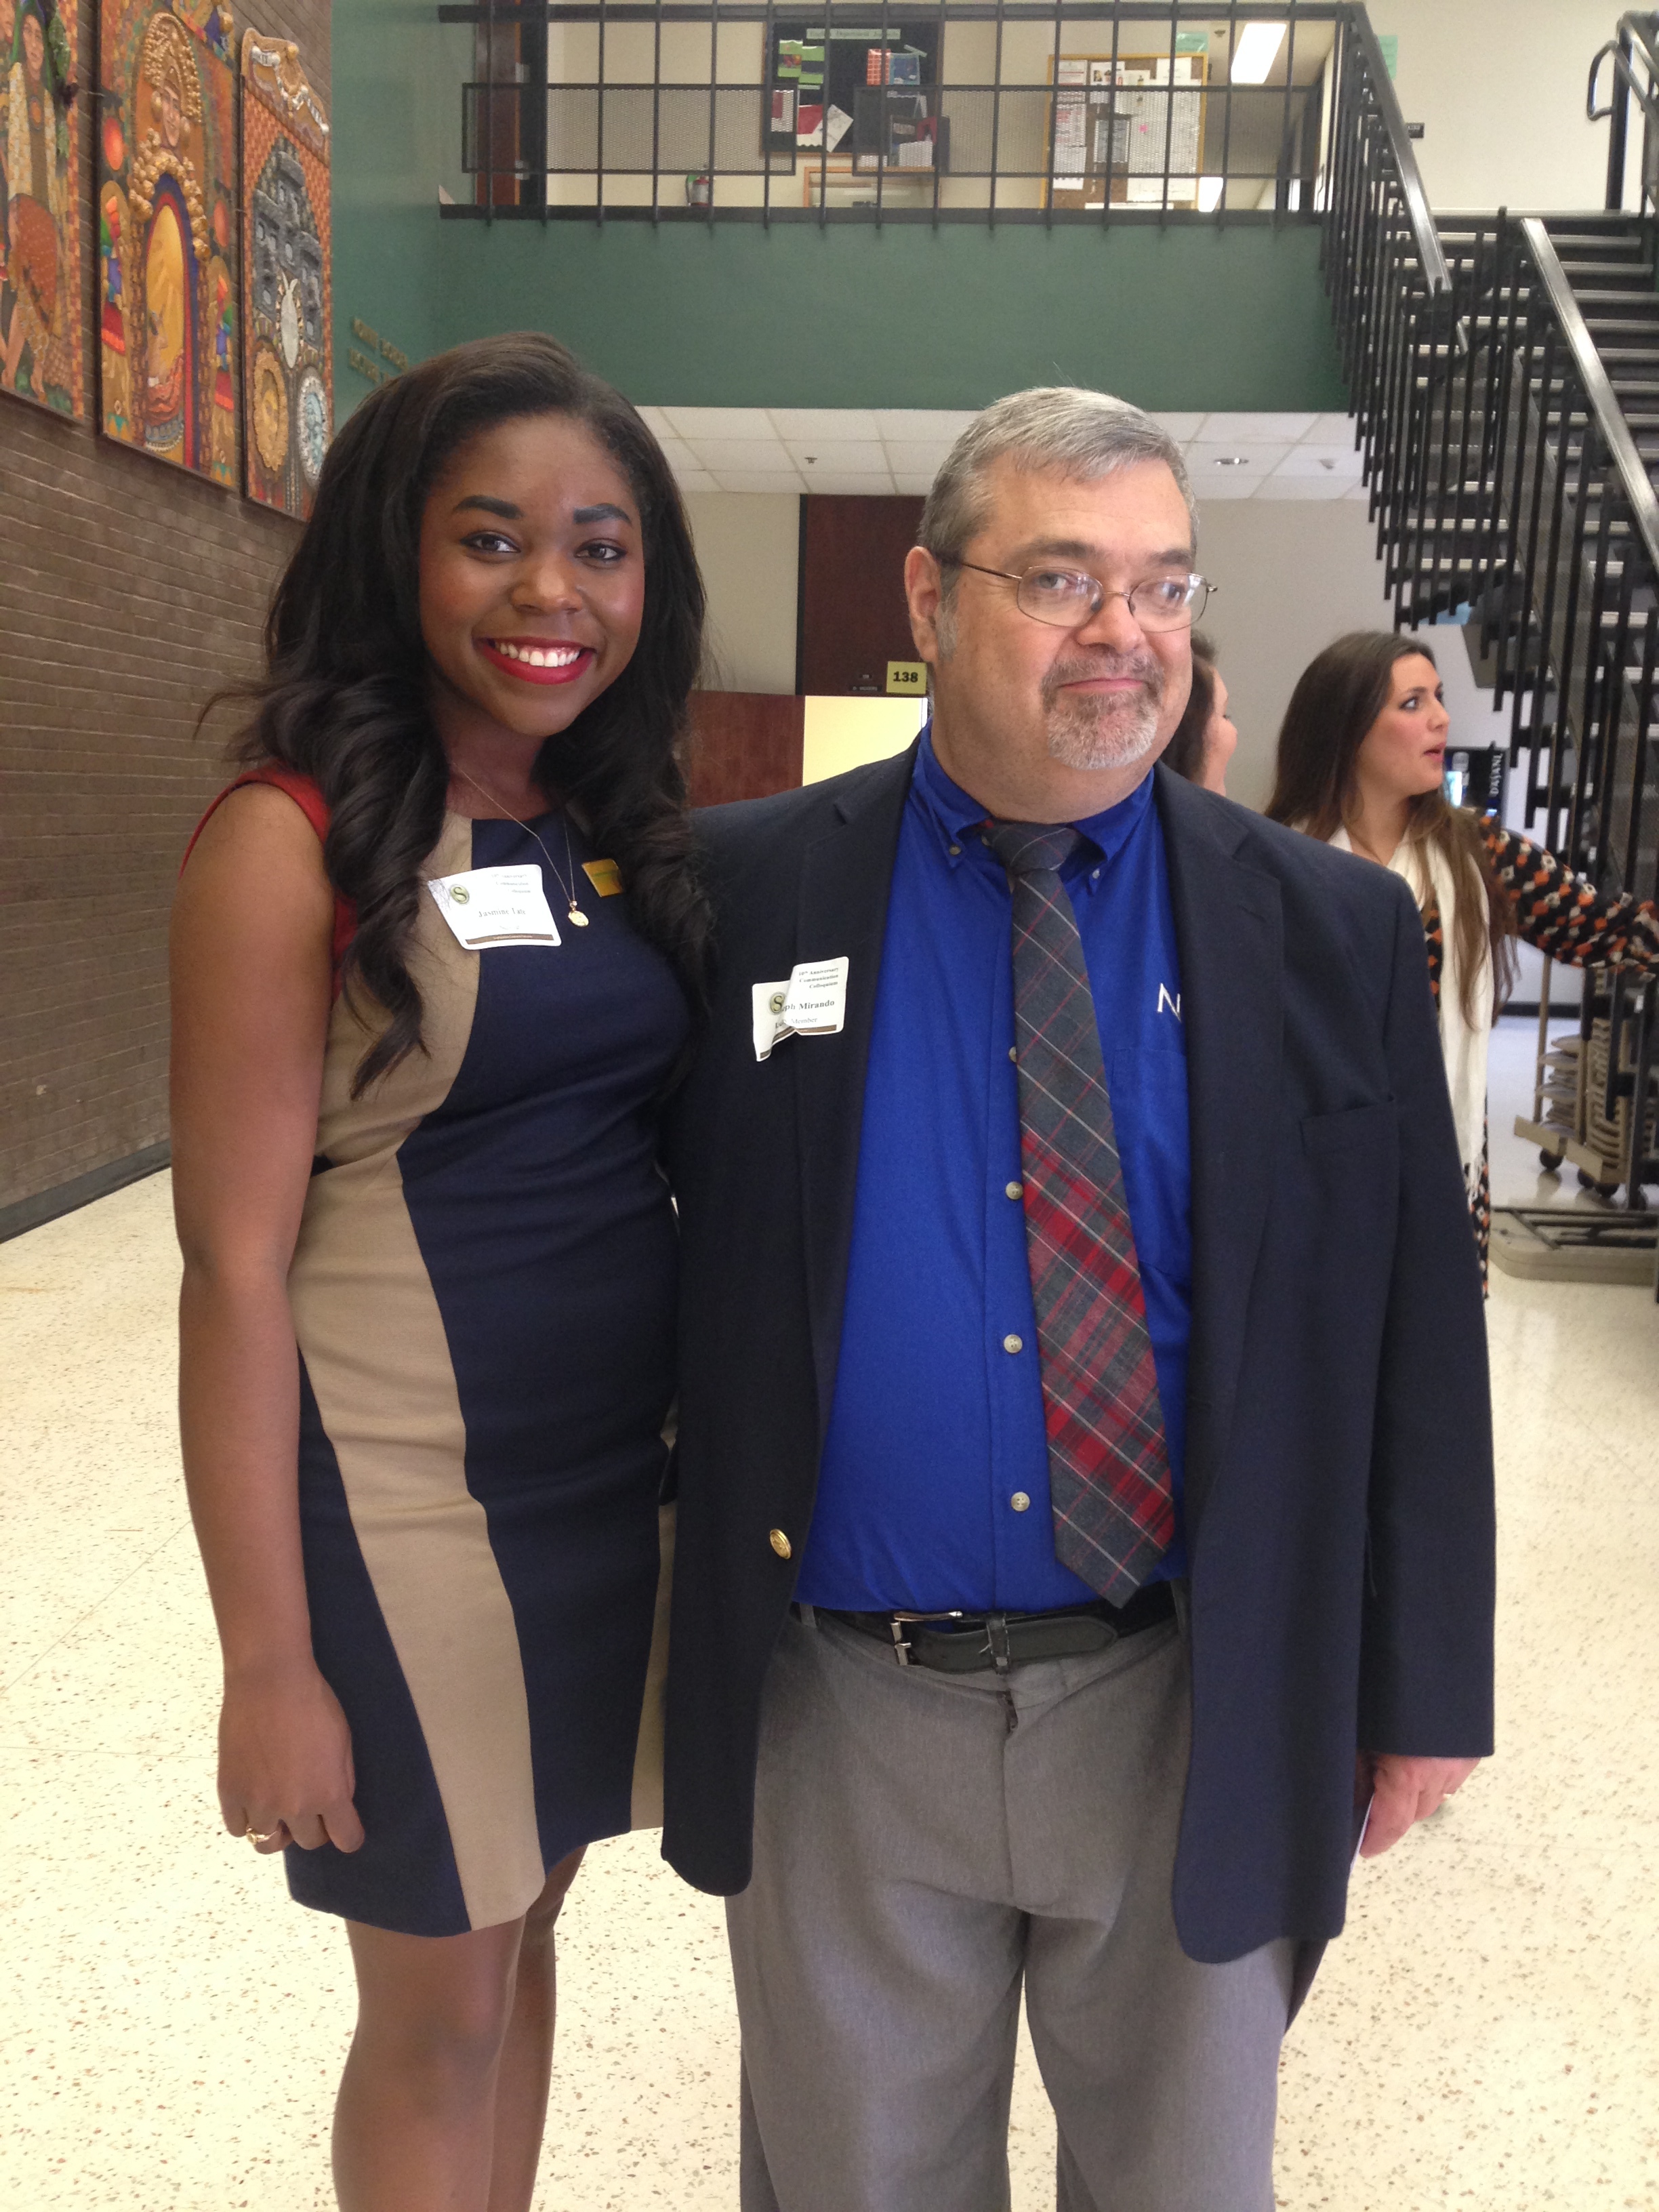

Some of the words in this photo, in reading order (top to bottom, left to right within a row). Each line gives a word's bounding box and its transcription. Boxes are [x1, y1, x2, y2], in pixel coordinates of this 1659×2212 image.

[893, 672, 918, 683] 138
[799, 974, 839, 983] Communication
[798, 1000, 835, 1010] Mirando
